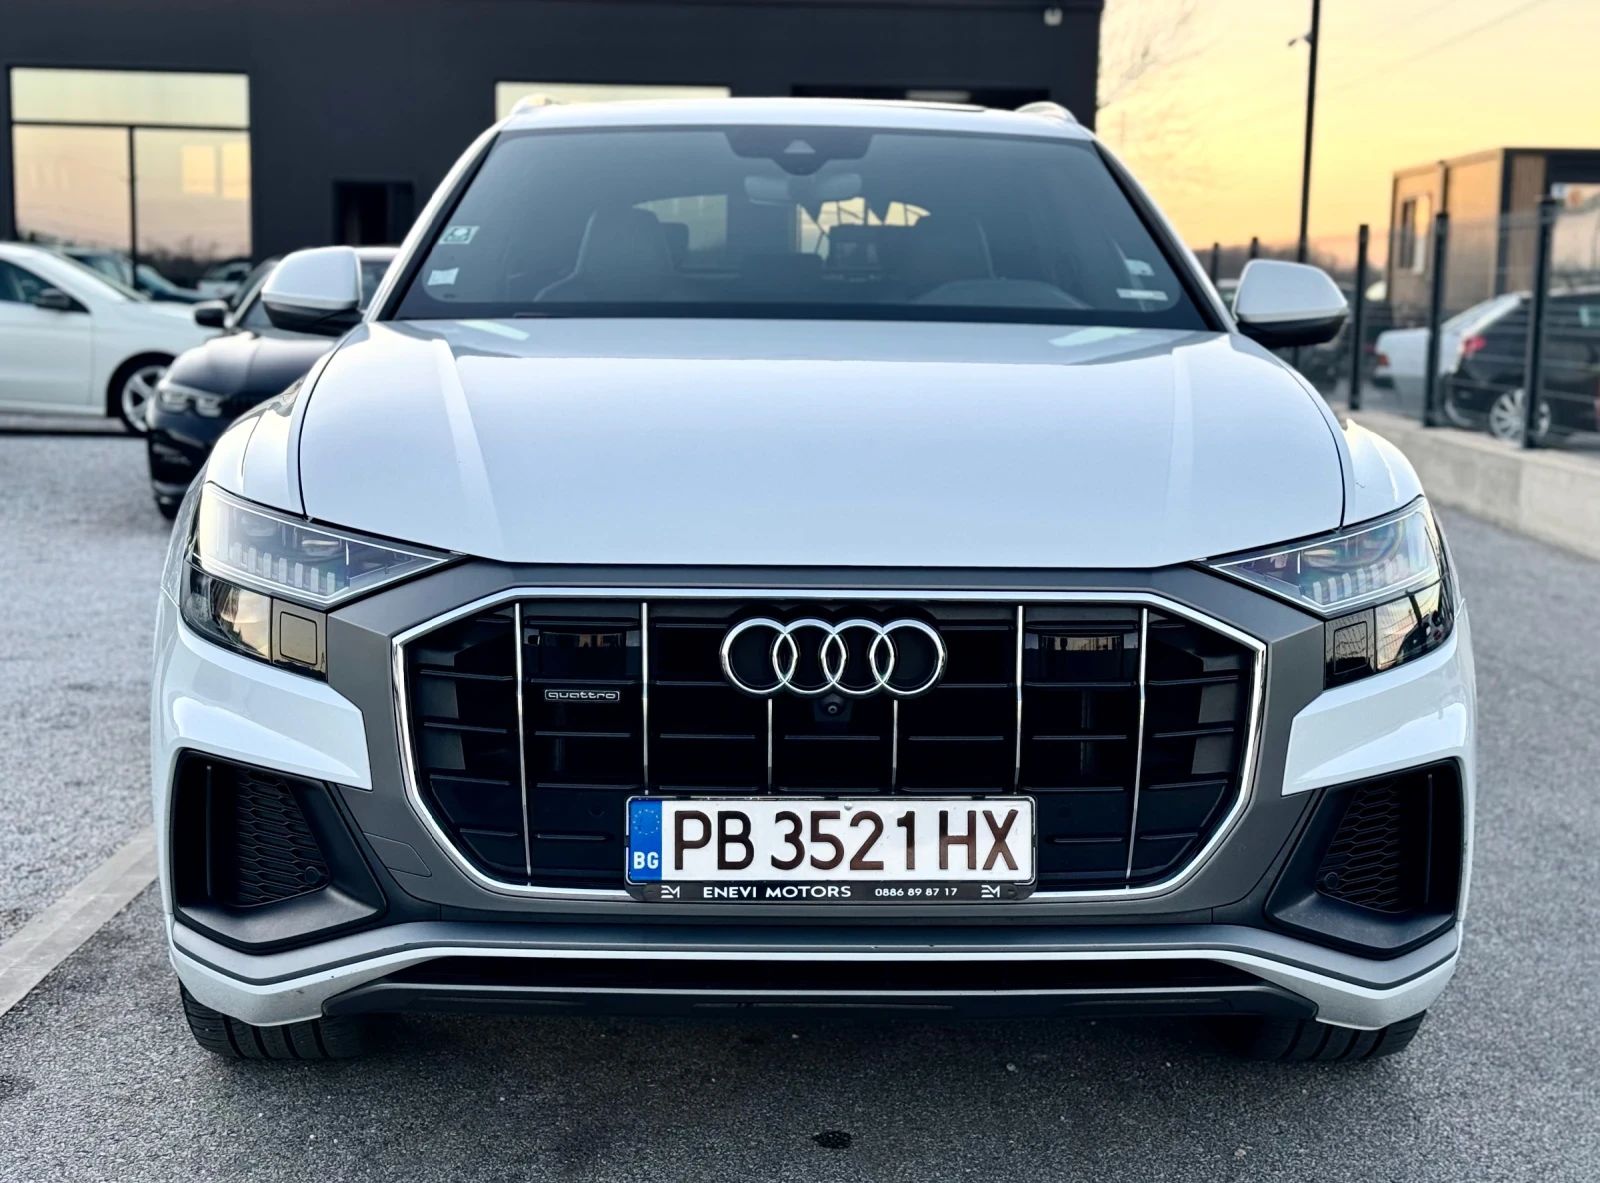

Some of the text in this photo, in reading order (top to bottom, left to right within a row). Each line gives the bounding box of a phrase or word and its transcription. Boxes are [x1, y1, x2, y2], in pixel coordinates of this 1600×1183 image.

[547, 691, 616, 699] quattro
[674, 809, 1019, 870] PB 3521 HX
[633, 851, 659, 869] BG
[703, 885, 851, 898] ENEVI MOTORS
[874, 888, 958, 897] 0886 89 87 17
